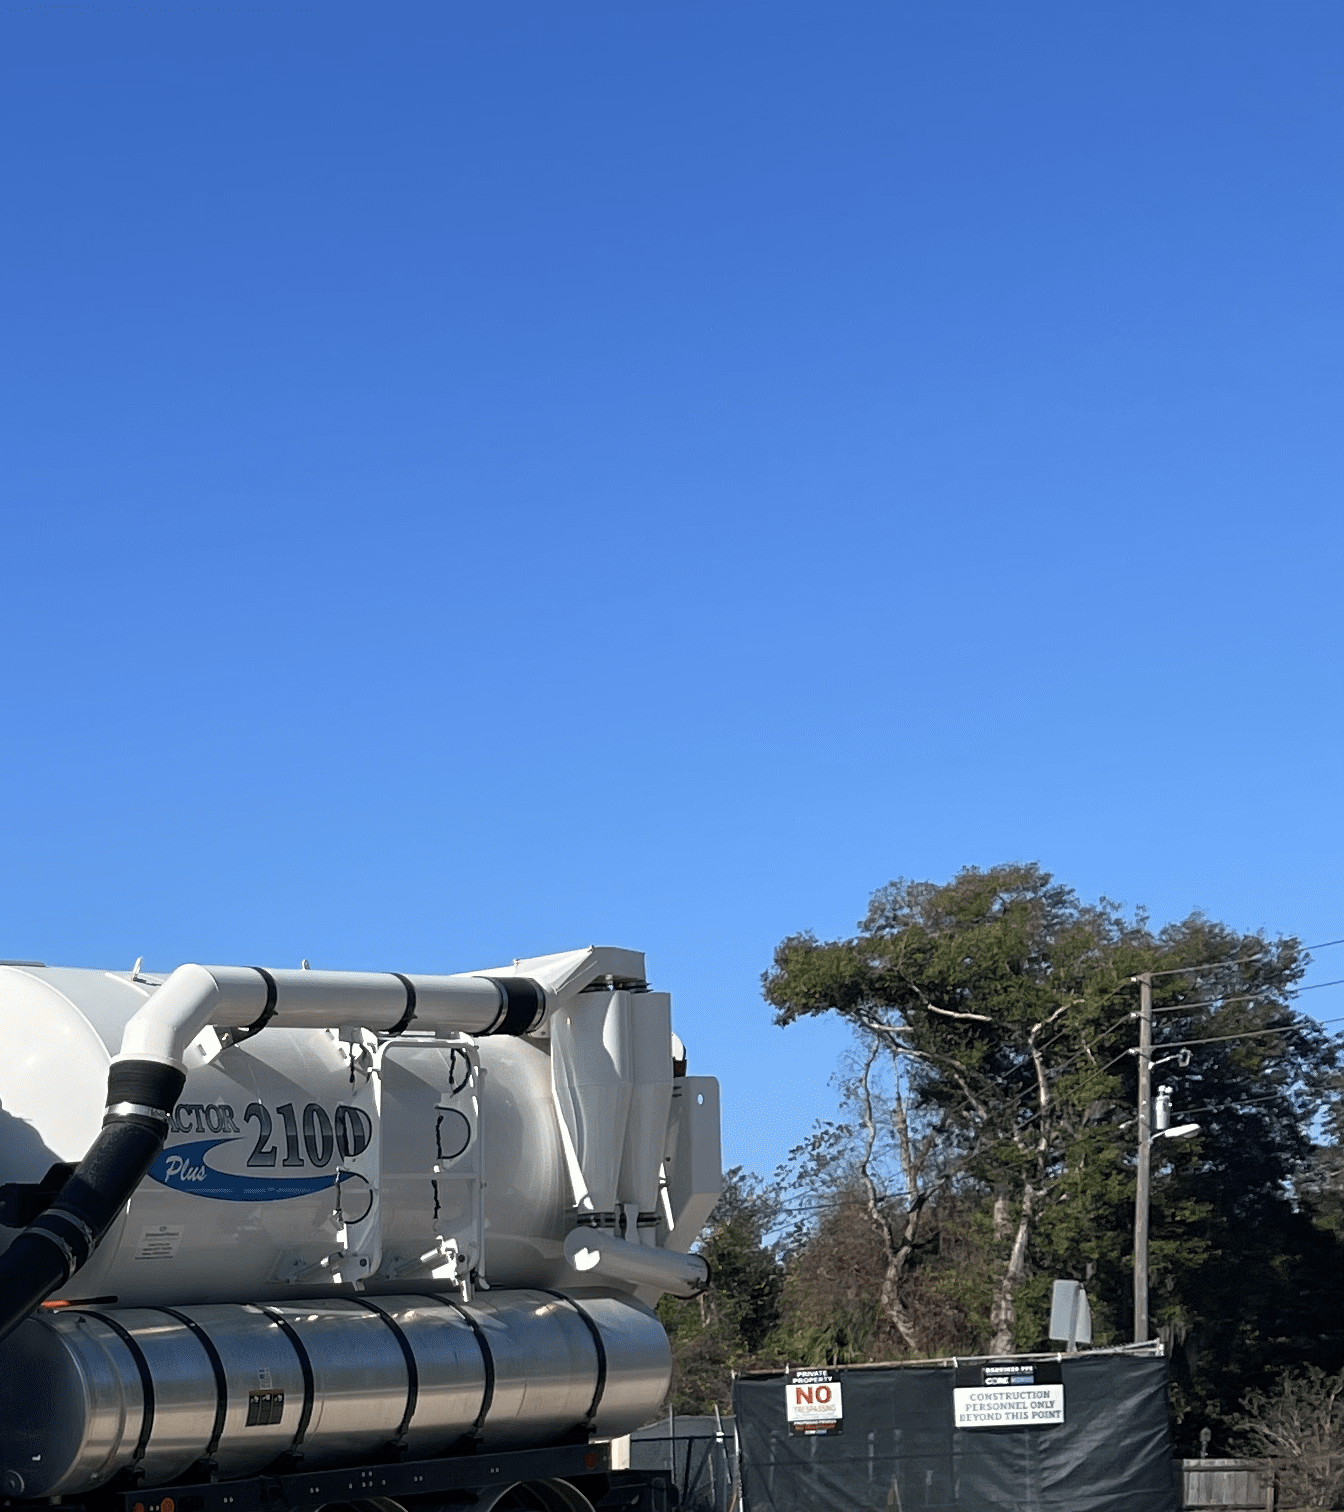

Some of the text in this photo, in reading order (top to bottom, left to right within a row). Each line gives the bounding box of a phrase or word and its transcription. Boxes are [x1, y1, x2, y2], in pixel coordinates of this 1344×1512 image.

[244, 1103, 365, 1167] 2100
[165, 1155, 207, 1182] Plus
[796, 1385, 832, 1404] NO
[969, 1390, 1051, 1402] CONSTRUCTION
[964, 1400, 1056, 1412] PERSONNEL ONLY
[959, 1409, 1062, 1422] BEYOND THIS POINT
